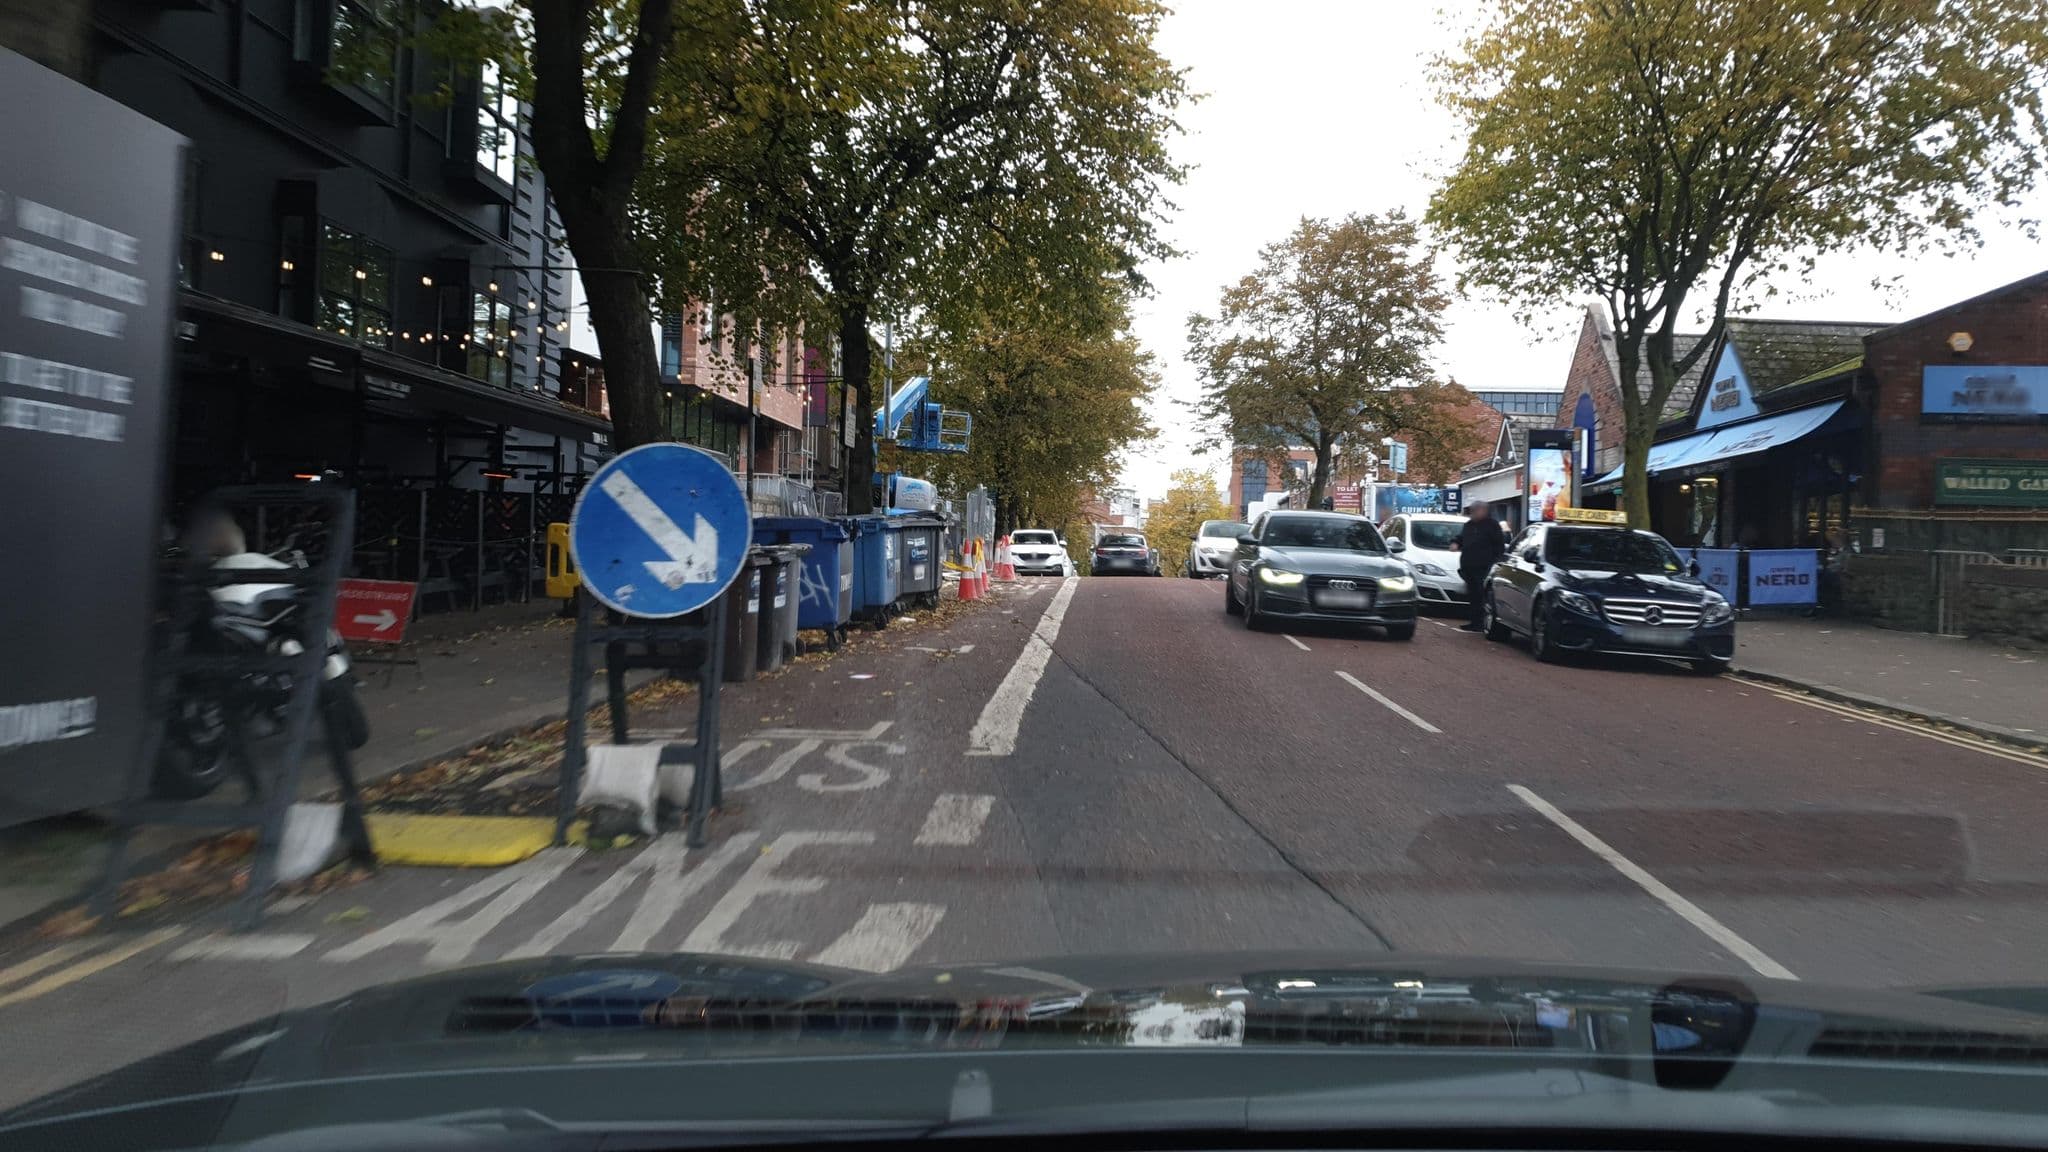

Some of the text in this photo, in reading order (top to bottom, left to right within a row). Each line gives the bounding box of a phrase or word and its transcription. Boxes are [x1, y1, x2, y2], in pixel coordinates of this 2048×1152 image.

[1952, 390, 2031, 407] NE
[1943, 477, 2011, 490] WALLED
[1756, 573, 1810, 586] NERO
